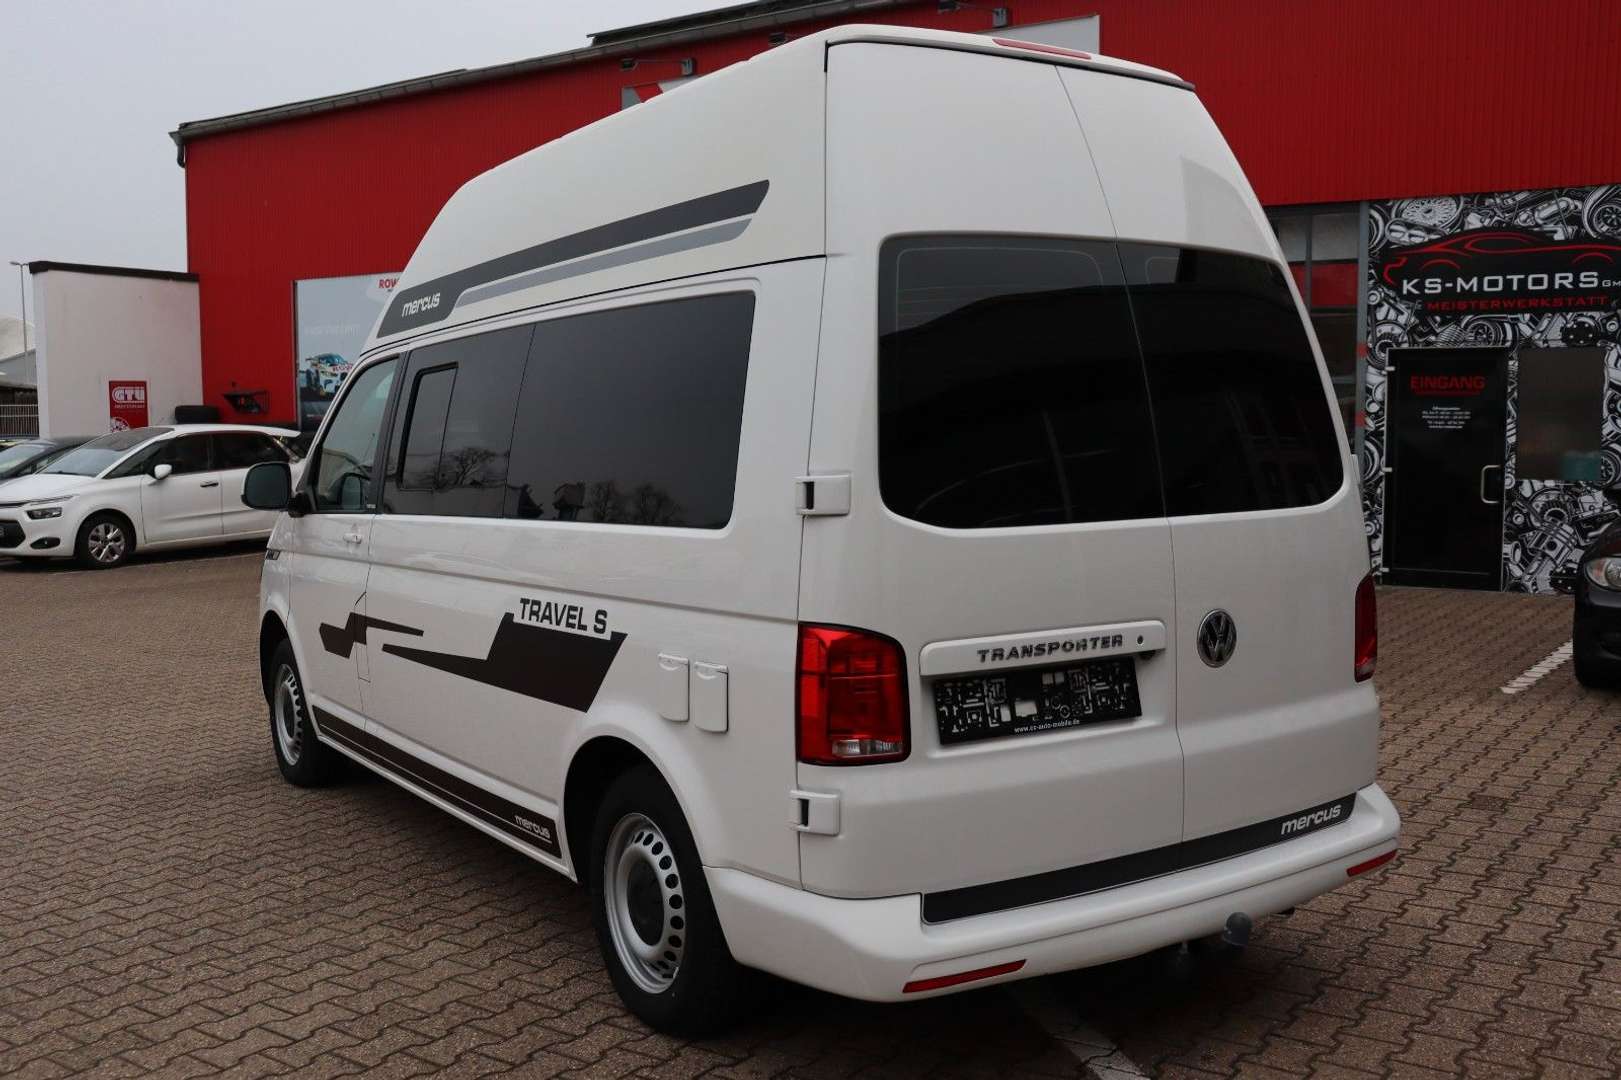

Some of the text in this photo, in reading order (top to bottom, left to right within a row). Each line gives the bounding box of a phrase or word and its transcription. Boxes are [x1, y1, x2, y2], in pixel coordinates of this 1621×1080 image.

[1402, 271, 1599, 295] KS-MOTORS
[402, 292, 441, 318] mercus
[1427, 296, 1608, 312] MEISTERWERKSTATT
[1410, 375, 1486, 390] EINGANG
[520, 598, 608, 634] TRAVEL S
[977, 634, 1123, 663] TRANSPORTER
[514, 815, 551, 840] mercus
[1280, 804, 1342, 831] mercus
